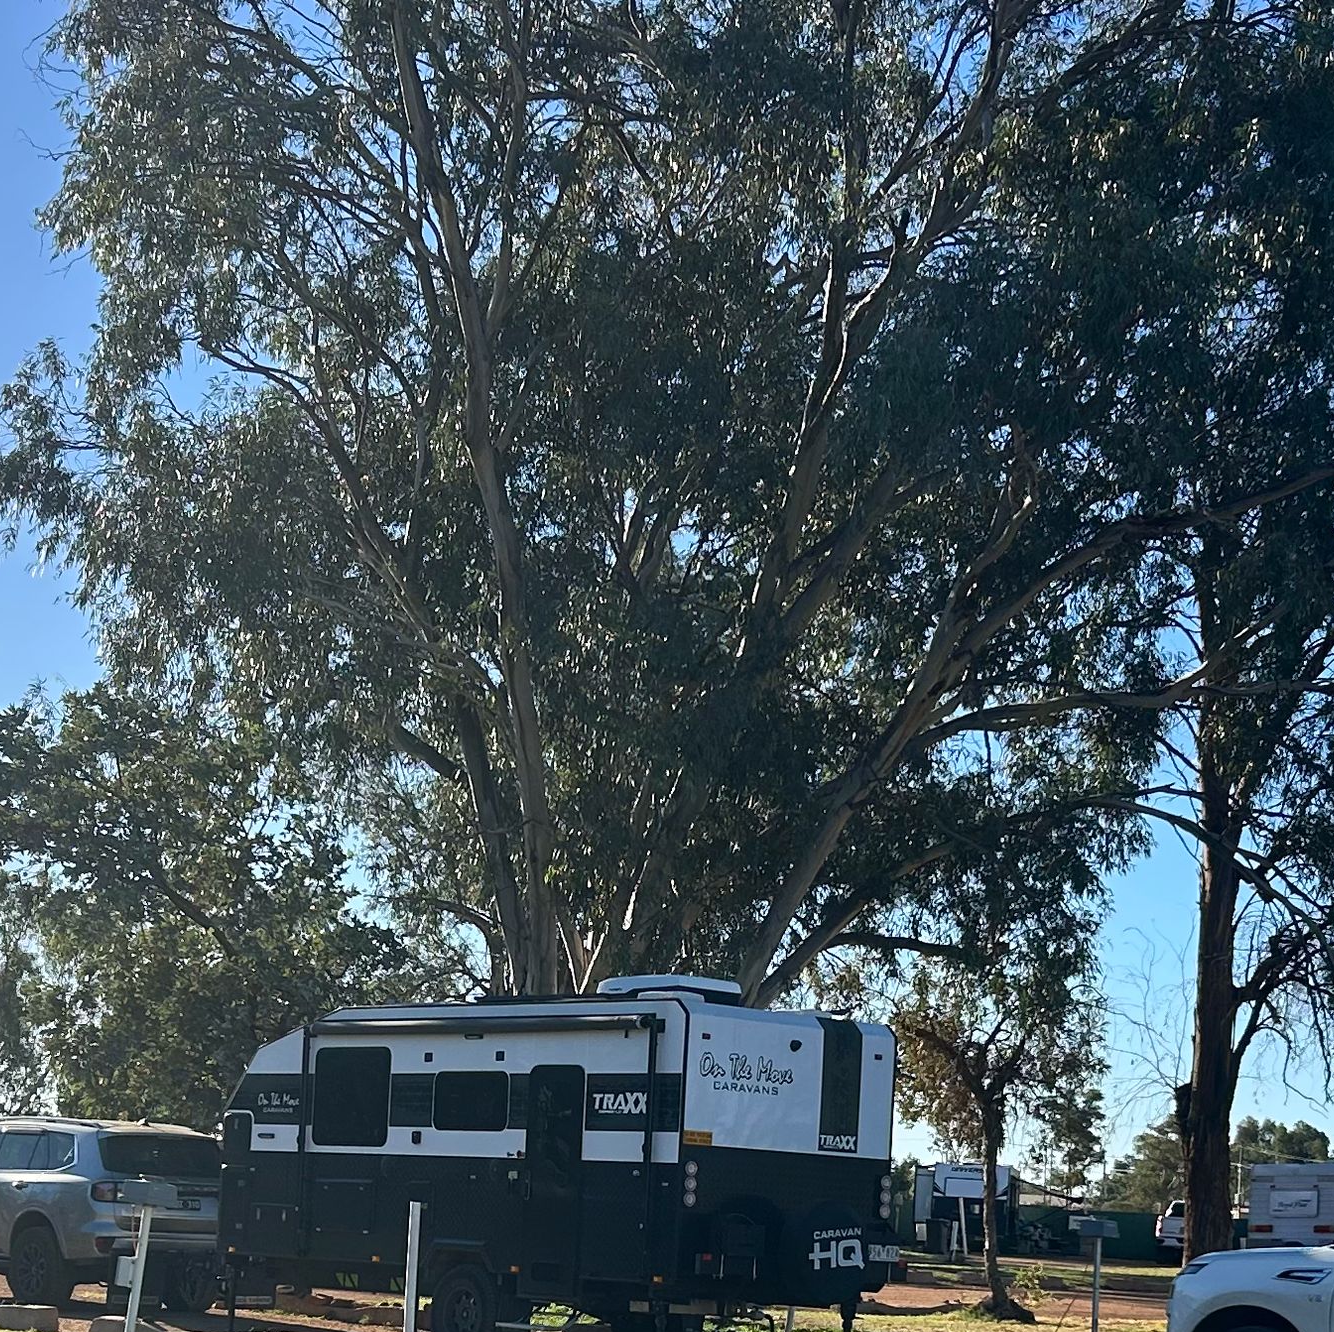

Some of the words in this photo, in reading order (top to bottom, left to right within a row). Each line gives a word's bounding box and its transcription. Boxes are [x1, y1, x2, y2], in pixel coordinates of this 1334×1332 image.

[700, 1051, 726, 1078] On
[729, 1053, 753, 1081] The
[756, 1055, 793, 1085] Move
[713, 1081, 779, 1096] CARAVANS
[592, 1092, 647, 1115] TRAXX
[820, 1134, 856, 1151] TRAXX
[813, 1227, 862, 1240] CARAVAN
[808, 1239, 865, 1270] HQ
